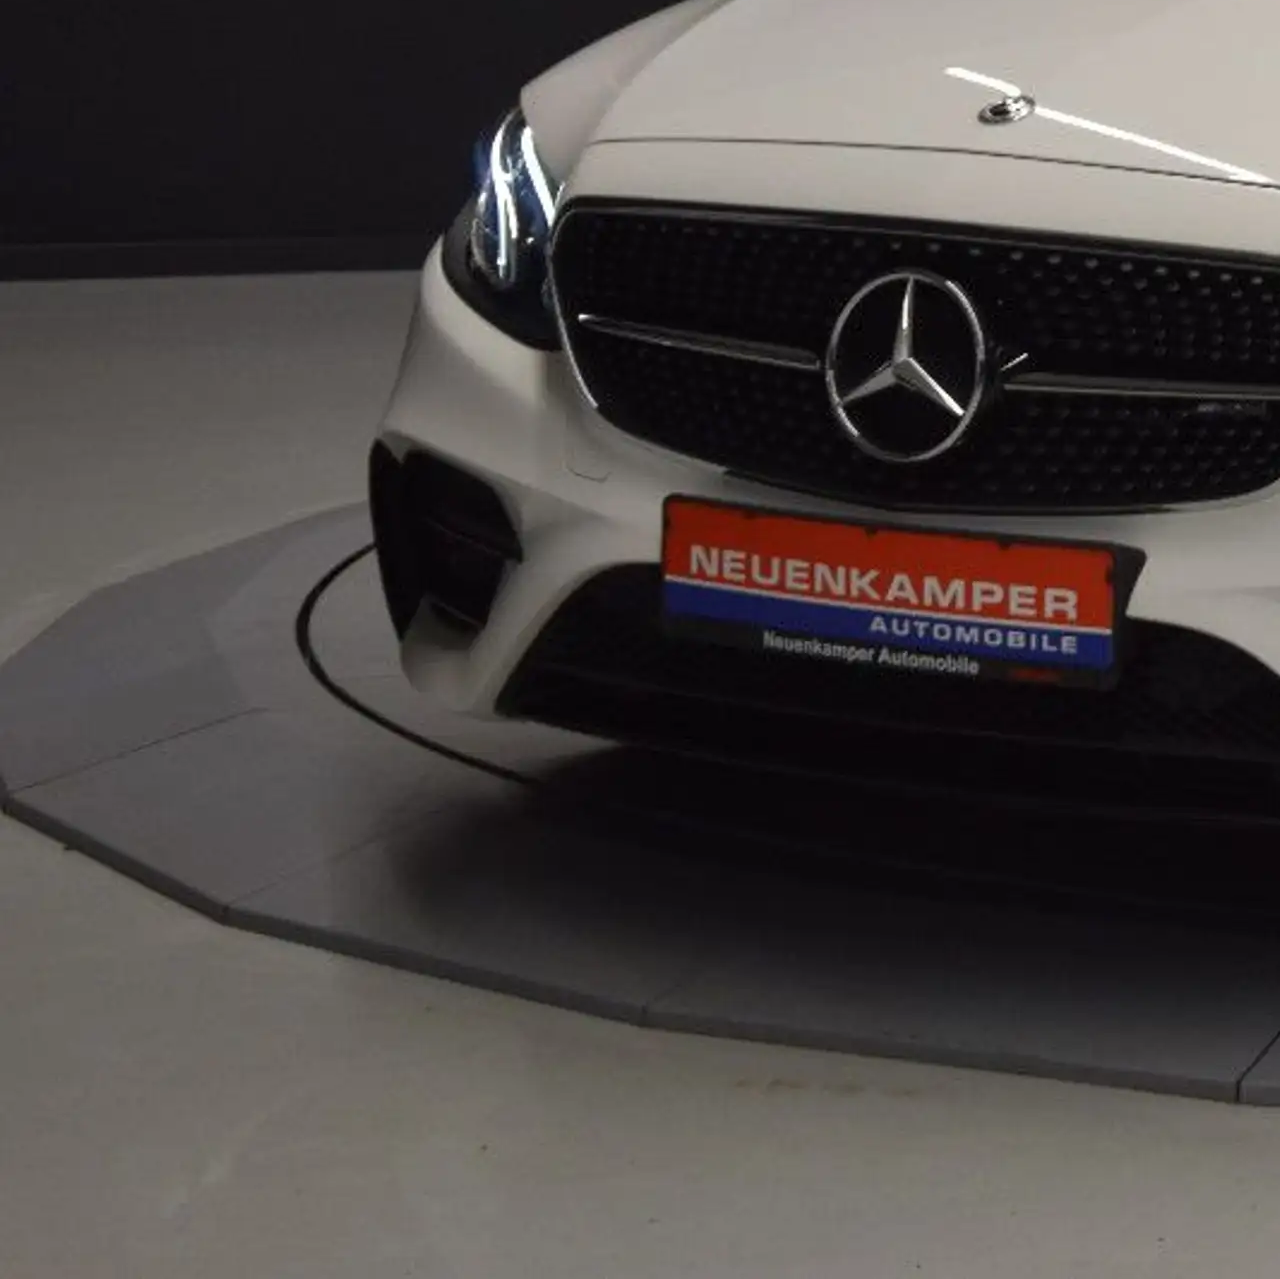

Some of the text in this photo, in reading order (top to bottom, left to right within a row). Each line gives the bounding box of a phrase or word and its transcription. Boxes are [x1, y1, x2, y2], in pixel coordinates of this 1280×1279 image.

[690, 543, 1078, 621] NEUENKAMPER
[763, 630, 980, 675] Neuenkamper Automobile
[869, 616, 1078, 655] AUTOMOBILE
